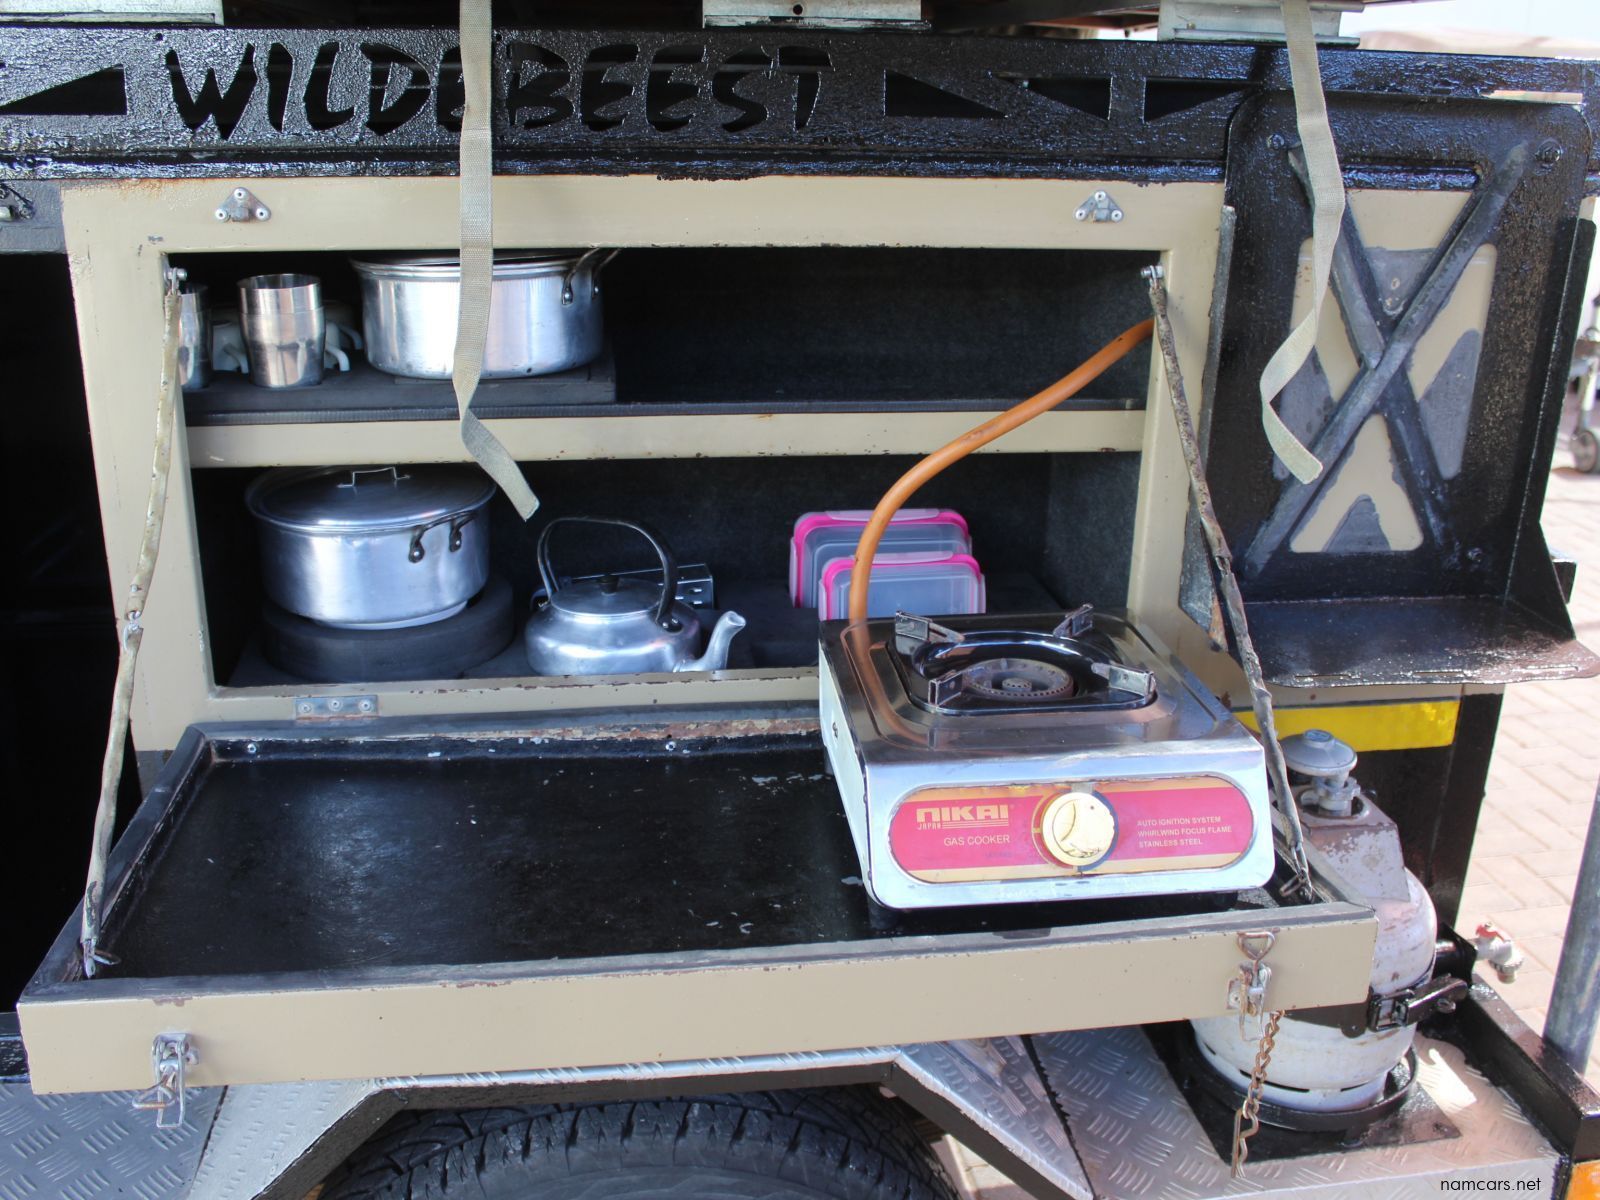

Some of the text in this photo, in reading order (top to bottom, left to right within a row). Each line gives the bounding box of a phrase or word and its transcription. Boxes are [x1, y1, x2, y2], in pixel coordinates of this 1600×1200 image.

[916, 804, 1009, 822] NIKAI
[917, 822, 941, 830] JAPAN
[1136, 816, 1221, 827] AUTO IGNITION SYSTEM
[1137, 825, 1232, 838] WHIRLWIND FOCUS FLAME
[943, 834, 1010, 846] GAS COOKER
[1138, 839, 1178, 848] STAINLESS
